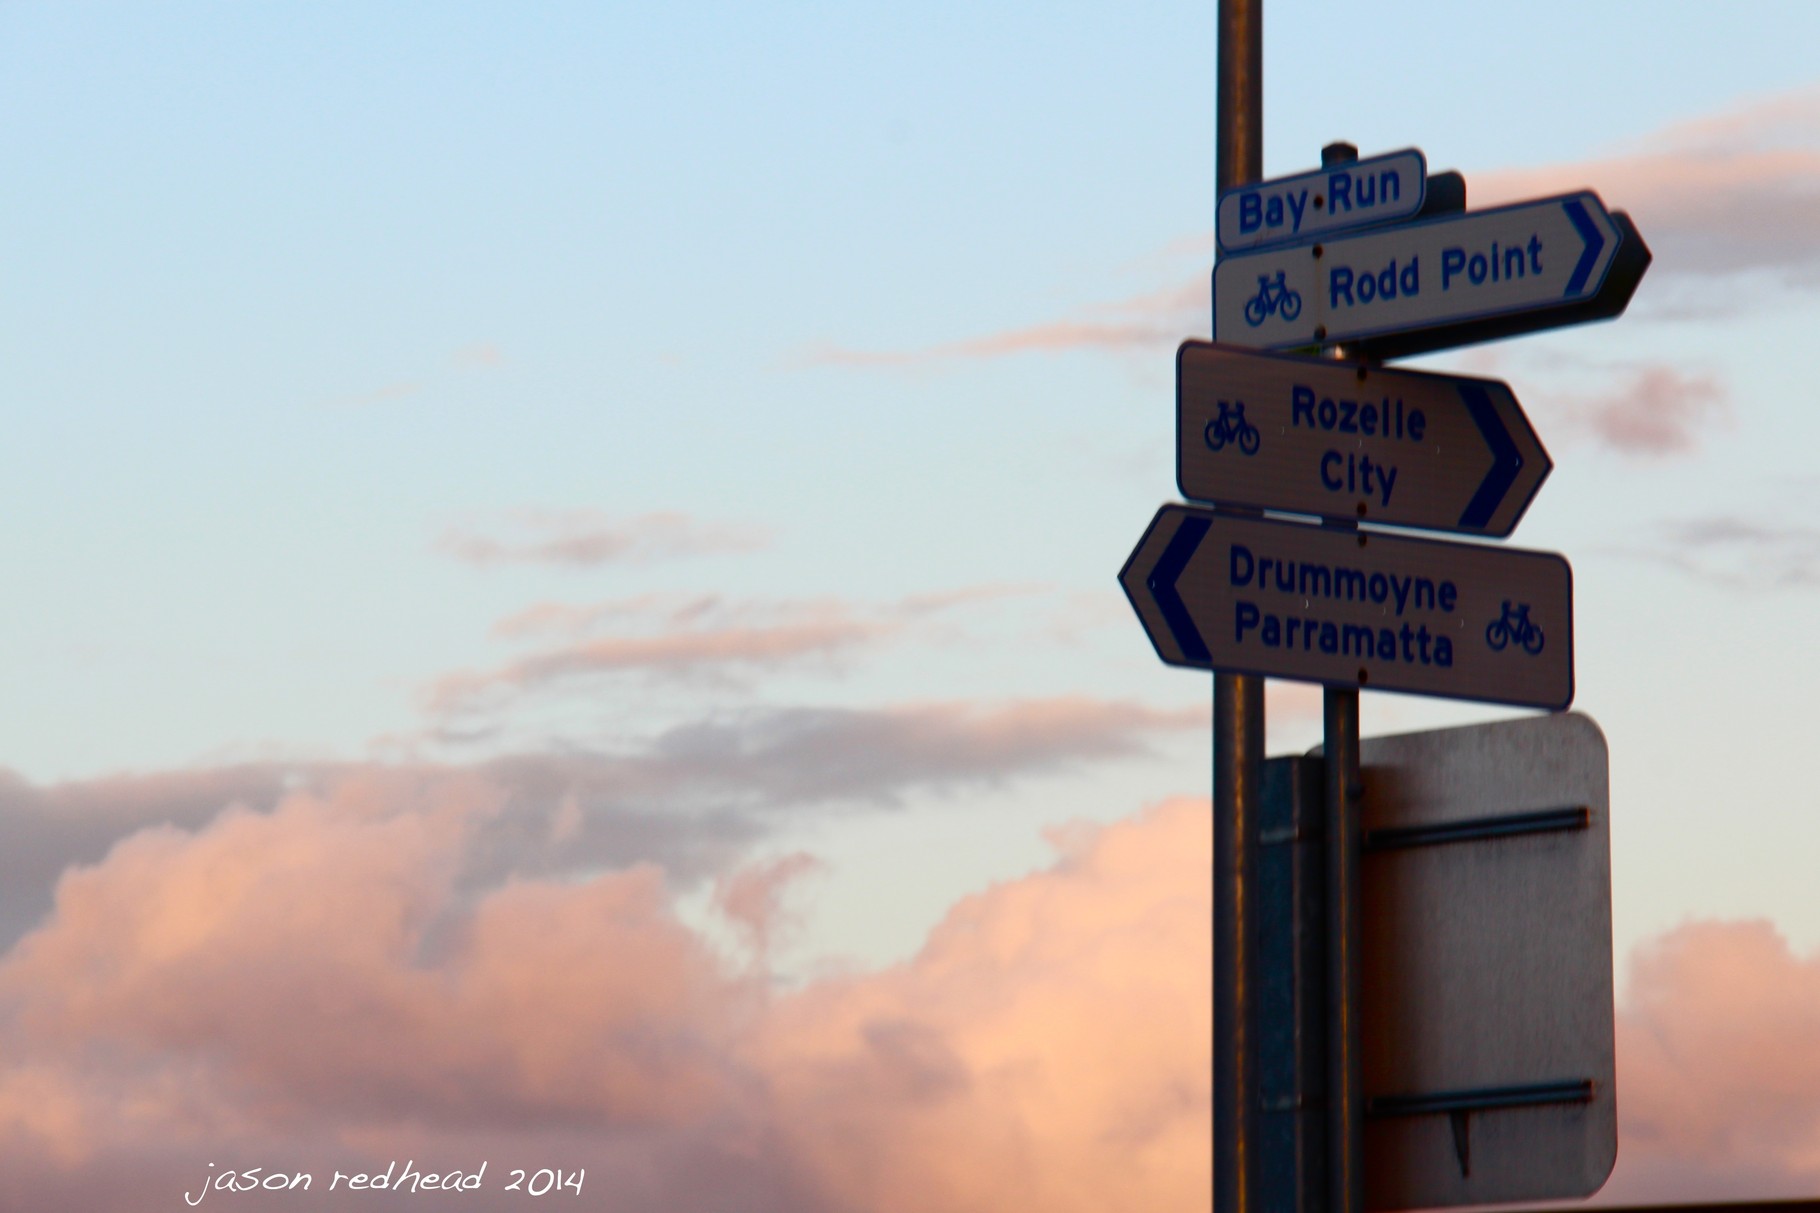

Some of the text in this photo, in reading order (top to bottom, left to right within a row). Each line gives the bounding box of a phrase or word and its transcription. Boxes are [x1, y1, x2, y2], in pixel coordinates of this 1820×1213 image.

[1239, 168, 1400, 235] Bay Run
[1329, 233, 1543, 309] Rodd Point
[1291, 384, 1427, 442] Rozelle
[1320, 450, 1398, 507] City
[1229, 544, 1458, 615] Drummoyne
[1235, 602, 1454, 667] Parramatta
